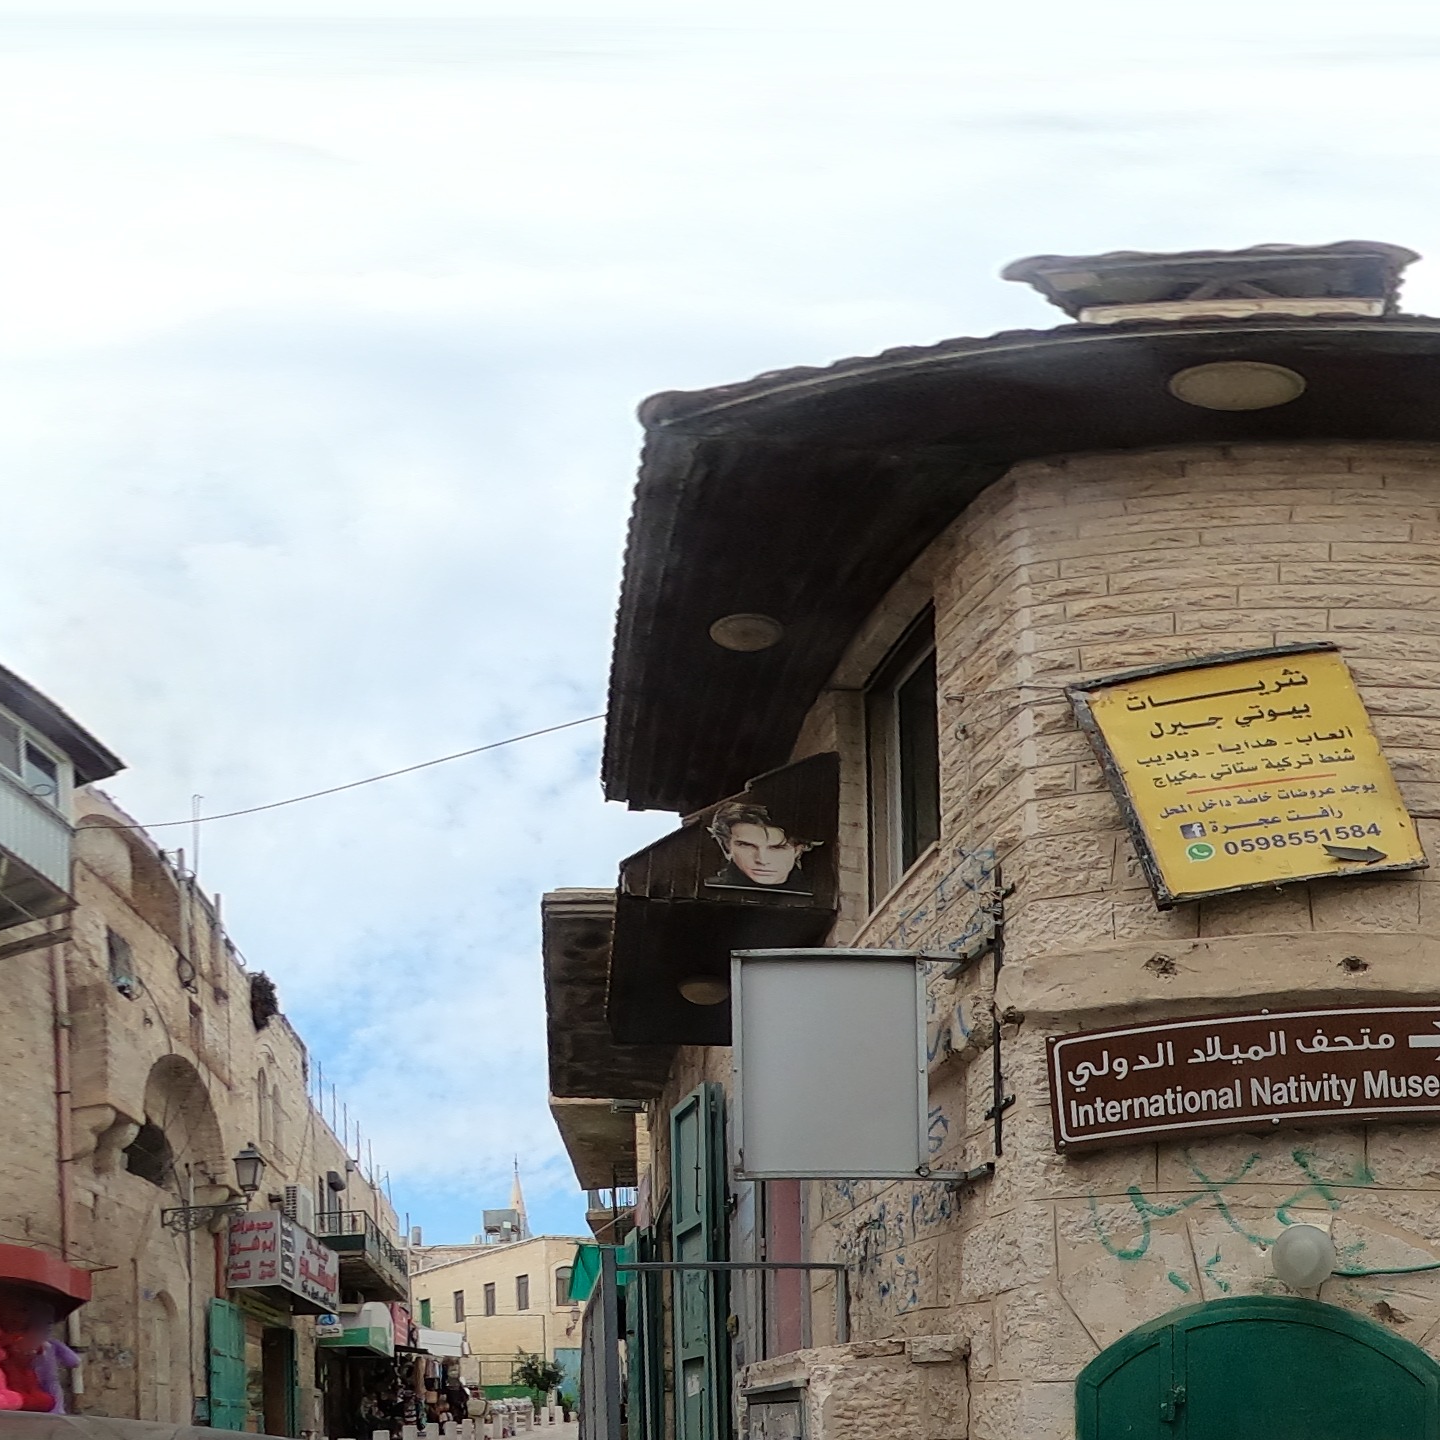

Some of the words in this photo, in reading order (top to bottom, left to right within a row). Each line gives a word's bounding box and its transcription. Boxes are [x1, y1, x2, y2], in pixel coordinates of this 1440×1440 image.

[1236, 702, 1311, 727] بيوتي
[1150, 715, 1223, 738] جيرل
[1219, 736, 1278, 755] هدايا
[1136, 748, 1199, 767] دباديب
[1261, 752, 1313, 771] تركية
[1319, 748, 1356, 764] شنط
[1236, 788, 1272, 806] خاصة
[1277, 784, 1336, 799] عروضات
[1341, 781, 1377, 796] يوجد
[1159, 803, 1193, 820] المحل
[1198, 797, 1232, 814] داخل
[1210, 814, 1281, 834] عجرة
[1224, 822, 1382, 856] 0598551584
[1187, 1031, 1287, 1065] الميلاد
[1296, 1029, 1395, 1052] متحف
[1067, 1042, 1173, 1092] الدولي
[1071, 1078, 1243, 1129] International
[1250, 1073, 1356, 1107] Nativity
